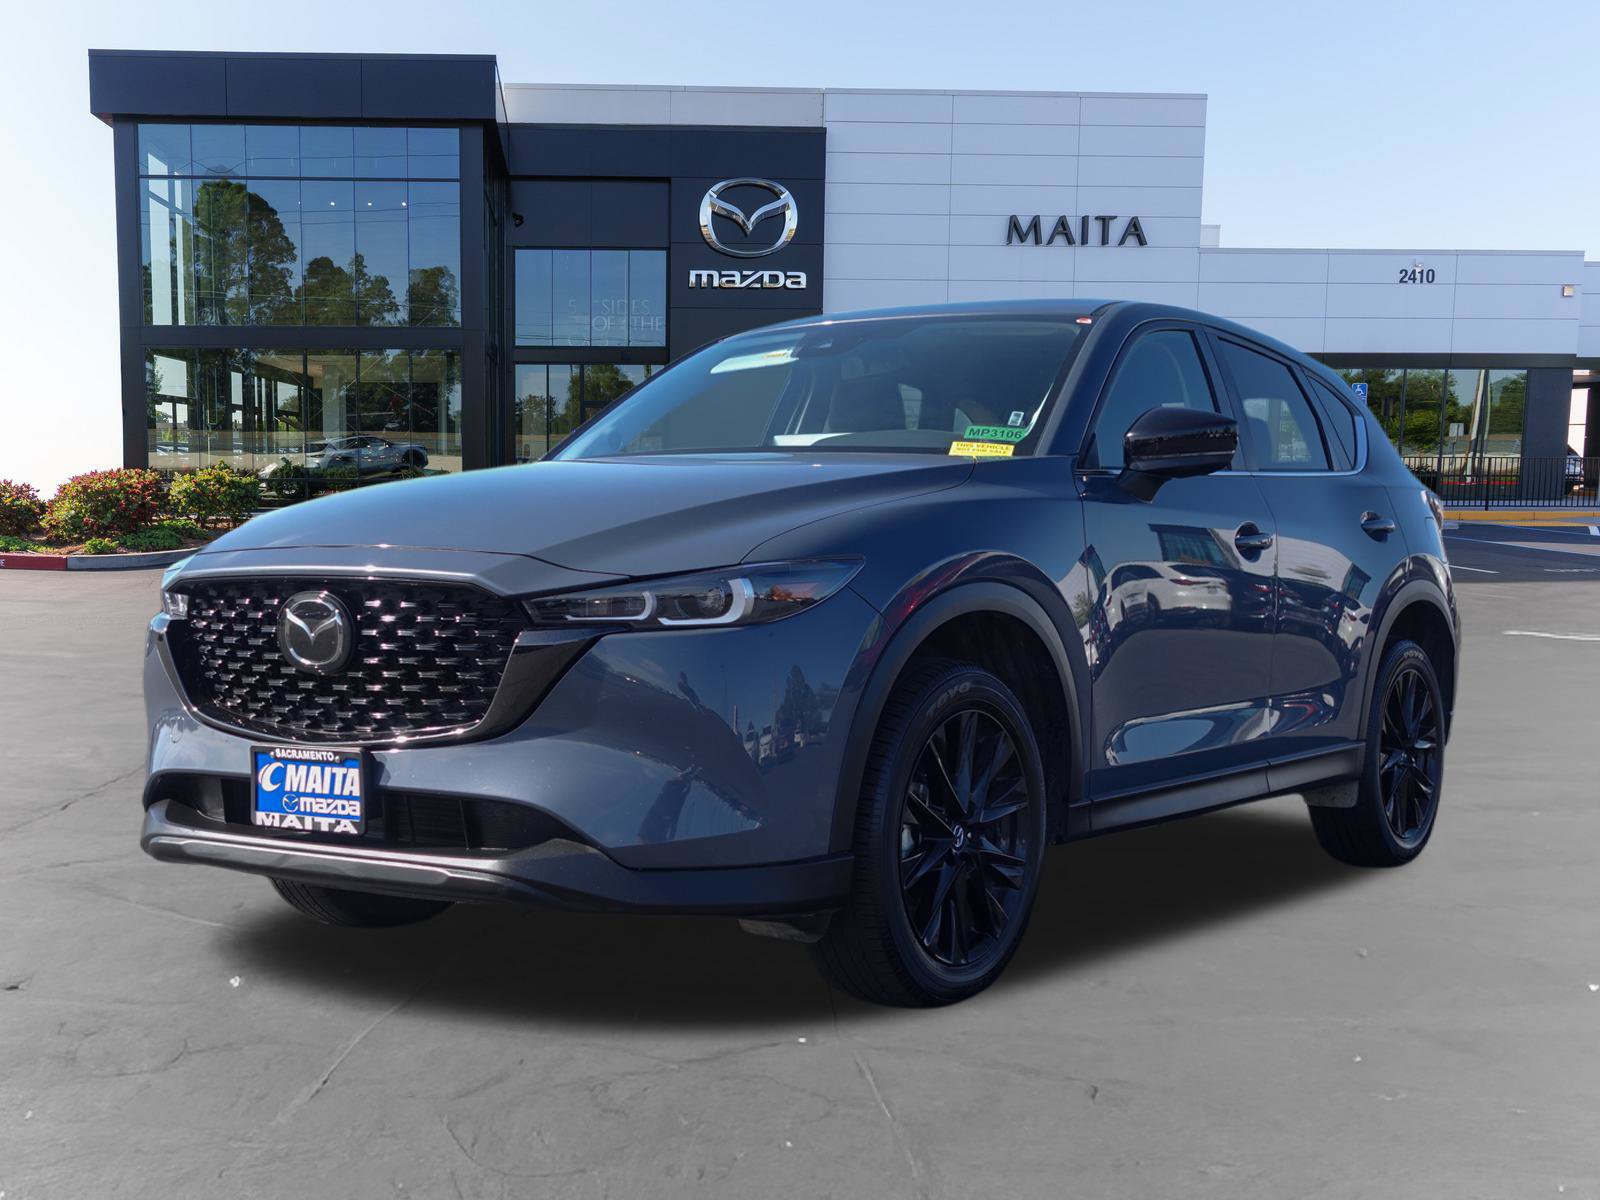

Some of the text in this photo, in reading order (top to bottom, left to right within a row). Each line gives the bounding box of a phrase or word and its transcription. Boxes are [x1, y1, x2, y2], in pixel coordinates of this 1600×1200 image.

[1006, 214, 1148, 246] MAITA
[688, 269, 807, 289] mazda
[1398, 268, 1436, 284] 2410
[600, 299, 650, 316] SIDES
[591, 315, 665, 332] OF THE
[968, 427, 1022, 439] MP3106
[275, 748, 335, 762] SACRAMENTO
[284, 763, 360, 797] MAITA
[299, 796, 360, 816] mazda
[256, 811, 358, 834] MAITA
